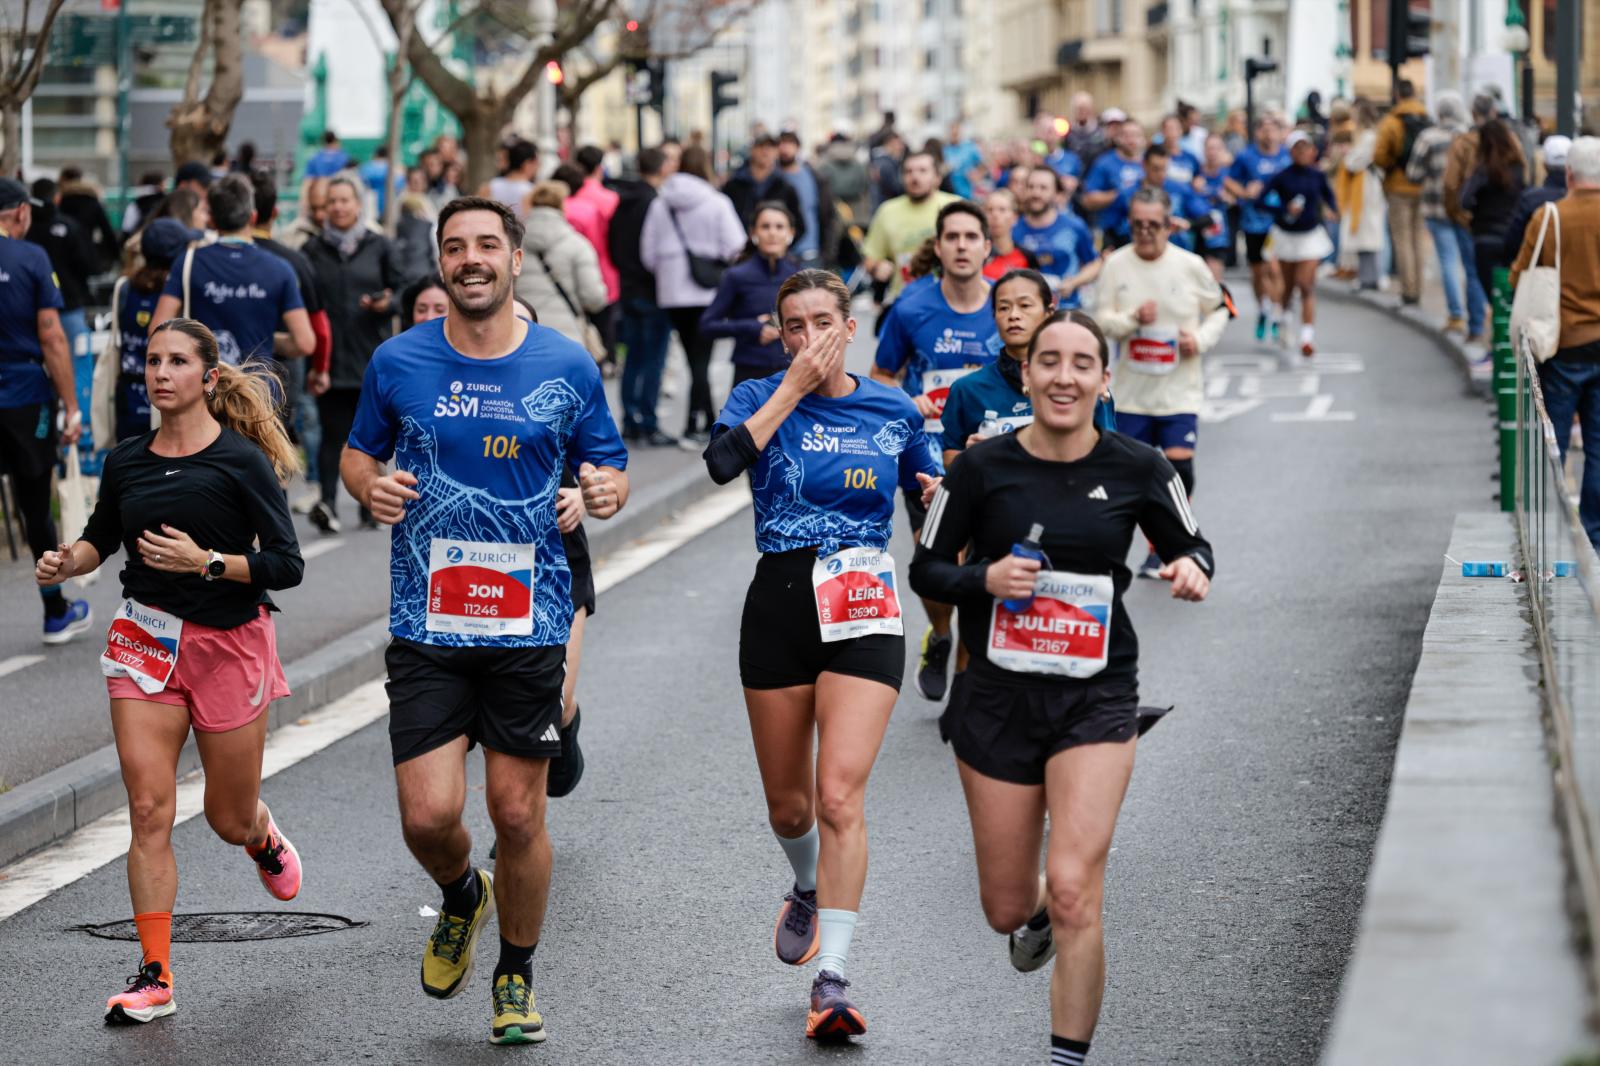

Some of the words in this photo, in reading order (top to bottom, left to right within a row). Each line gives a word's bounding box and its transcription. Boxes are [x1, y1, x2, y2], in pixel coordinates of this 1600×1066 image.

[466, 383, 502, 393] ZURICH
[434, 394, 479, 418] SSM
[481, 406, 514, 414] DONOSTIA
[483, 400, 514, 408] MARATÓN
[494, 414, 526, 422] SEBASTIÁN
[482, 434, 520, 460] 10k
[801, 432, 838, 453] SSM
[844, 468, 878, 490] 10k
[470, 552, 516, 563] ZURICH
[848, 556, 880, 567] ZURICH
[468, 584, 504, 598] JON
[848, 586, 884, 602] LEIRE
[1040, 582, 1093, 596] ZURICH
[432, 596, 441, 612] 10k
[464, 603, 498, 616] 11246
[822, 608, 831, 623] 10k
[848, 606, 878, 618] 12690
[1014, 614, 1100, 638] JULIETTE
[110, 628, 174, 665] VERÓNICA
[1032, 638, 1070, 654] 12167
